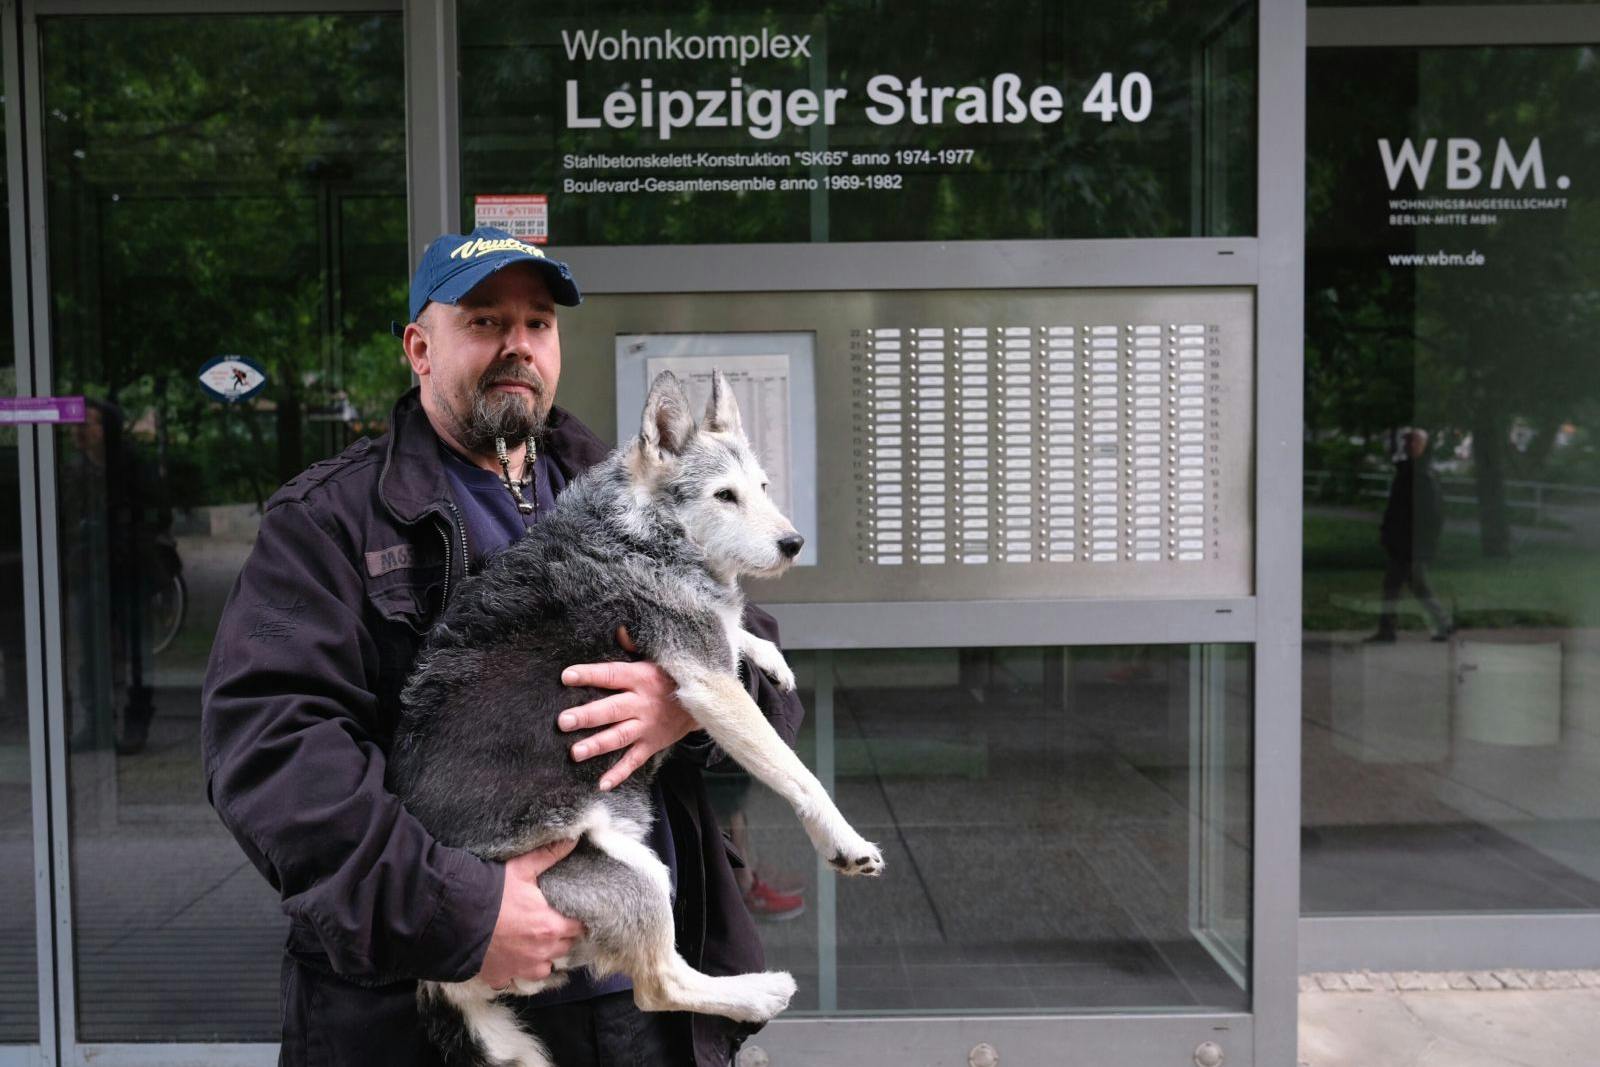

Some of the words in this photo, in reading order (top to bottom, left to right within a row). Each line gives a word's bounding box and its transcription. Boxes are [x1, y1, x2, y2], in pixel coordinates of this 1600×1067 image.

[562, 28, 811, 66] Wohnkomplex
[566, 78, 847, 140] Leipziger
[865, 73, 1063, 125] Straße
[1082, 71, 1153, 123] 40
[563, 153, 791, 169] Stahlbetonskelett-Konstruktion
[795, 151, 849, 166] "SK65"
[851, 154, 891, 167] anno
[895, 149, 975, 165] 1974-1977
[1378, 137, 1571, 191] WBM.
[563, 177, 777, 194] Boulevard-Gesamtensemble
[779, 178, 819, 192] anno
[822, 174, 903, 191] 1969-1982
[1389, 198, 1568, 210] WOHNUNGSBAUGESELLSCHAFT
[1389, 214, 1467, 225] BERLIN-MITTE
[1389, 250, 1486, 266] www.wbm.de
